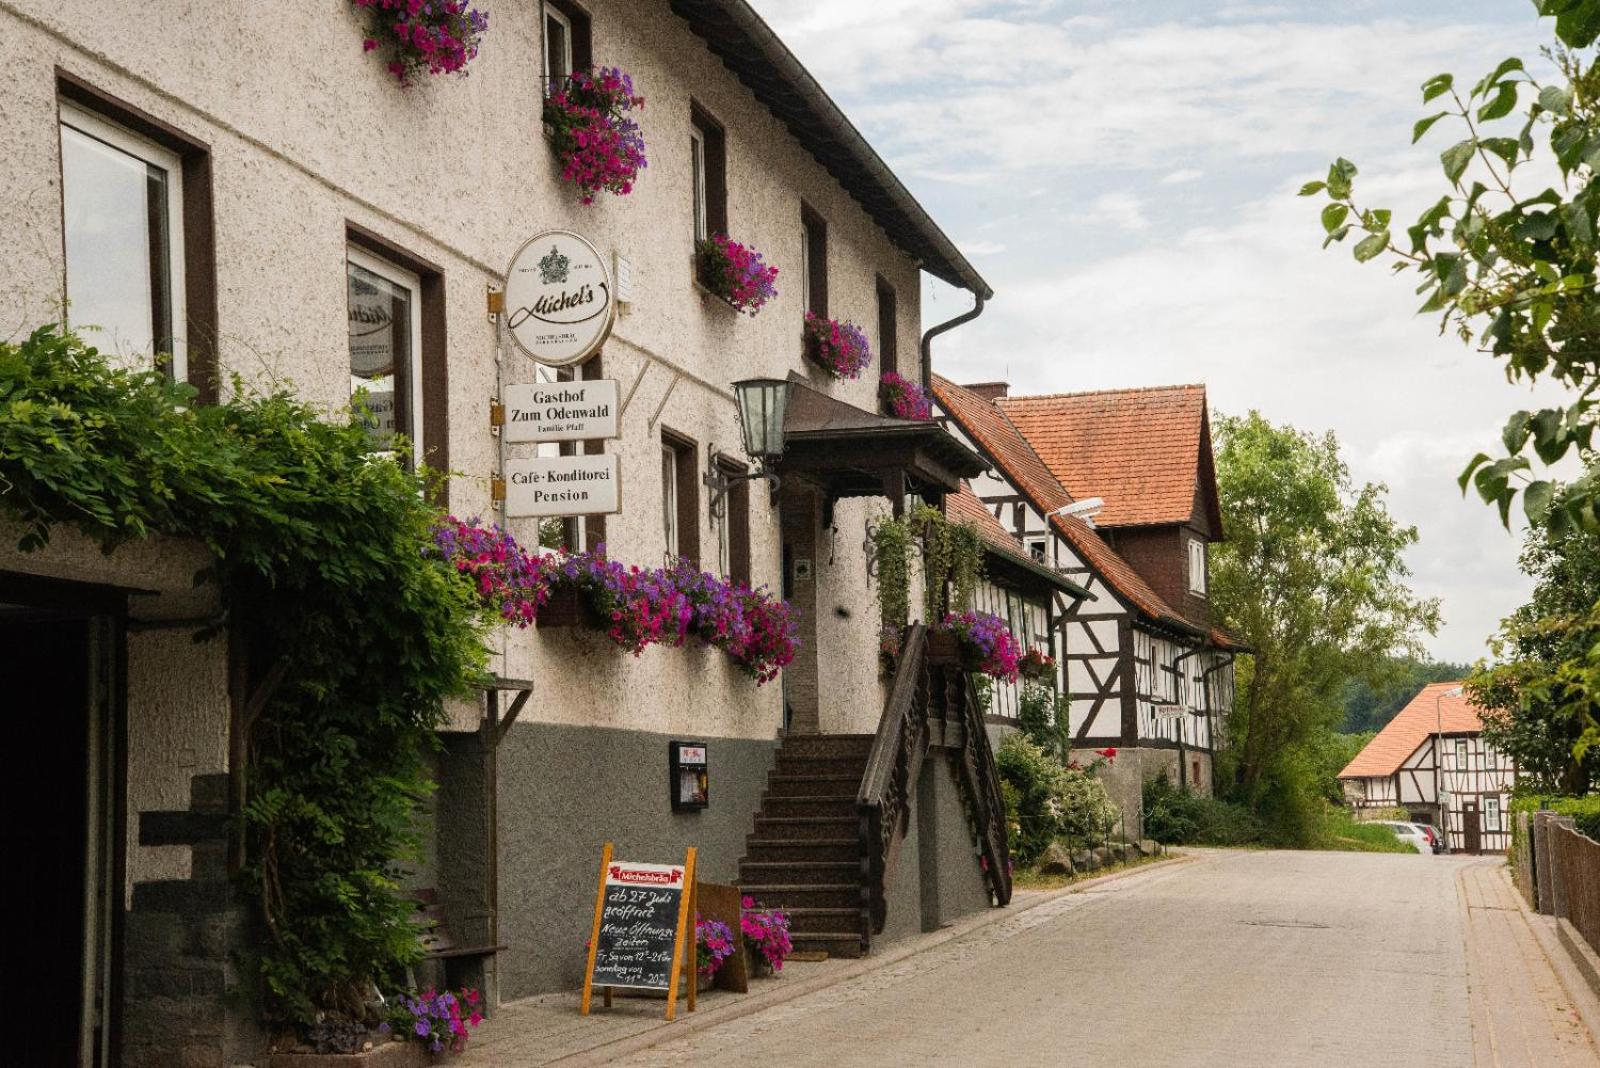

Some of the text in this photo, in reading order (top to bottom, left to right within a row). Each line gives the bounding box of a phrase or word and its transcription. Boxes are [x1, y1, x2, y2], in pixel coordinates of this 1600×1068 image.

[533, 389, 585, 404] Gasthof
[511, 405, 609, 422] Zum Odenwald
[538, 424, 564, 433] Familie
[547, 468, 610, 483] Konditorei
[534, 490, 589, 503] Pension
[609, 888, 627, 902] ab
[604, 904, 656, 920] geöffnet
